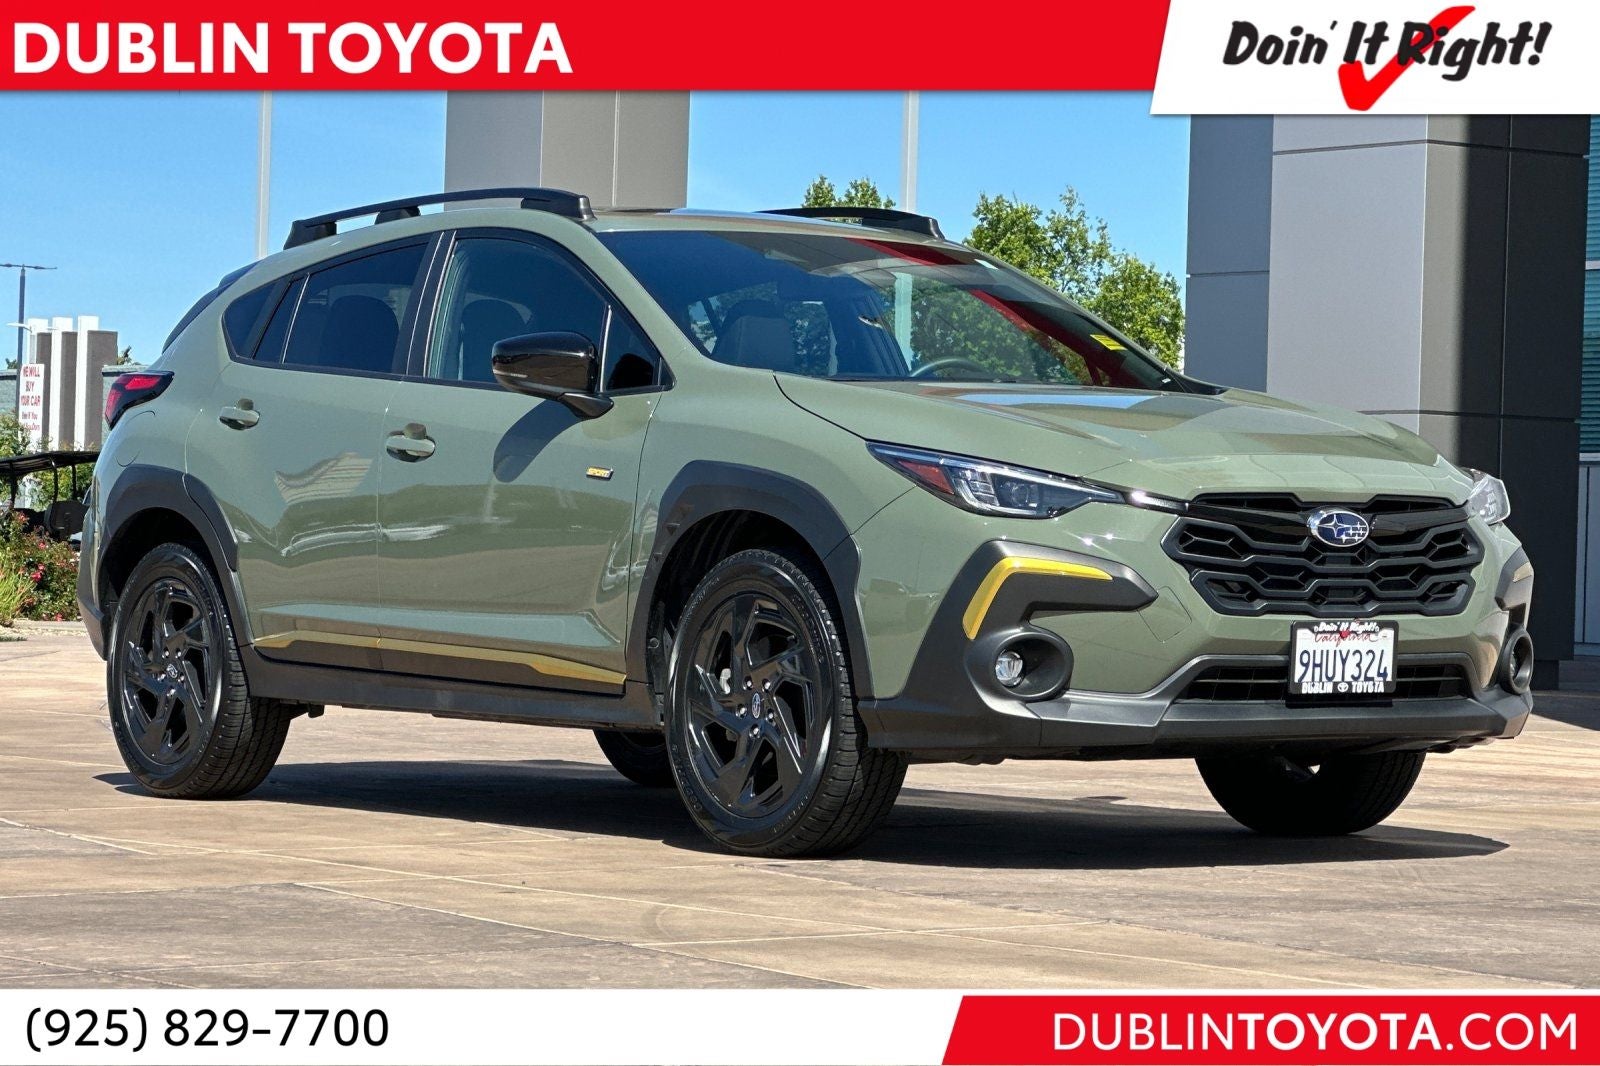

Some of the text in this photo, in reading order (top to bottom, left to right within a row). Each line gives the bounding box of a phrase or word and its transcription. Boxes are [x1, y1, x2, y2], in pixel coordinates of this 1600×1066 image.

[26, 381, 35, 392] BUY
[31, 395, 41, 406] CAR
[1298, 649, 1388, 682] 9HUY324
[1302, 681, 1385, 694] DUBLIN TOYOTA
